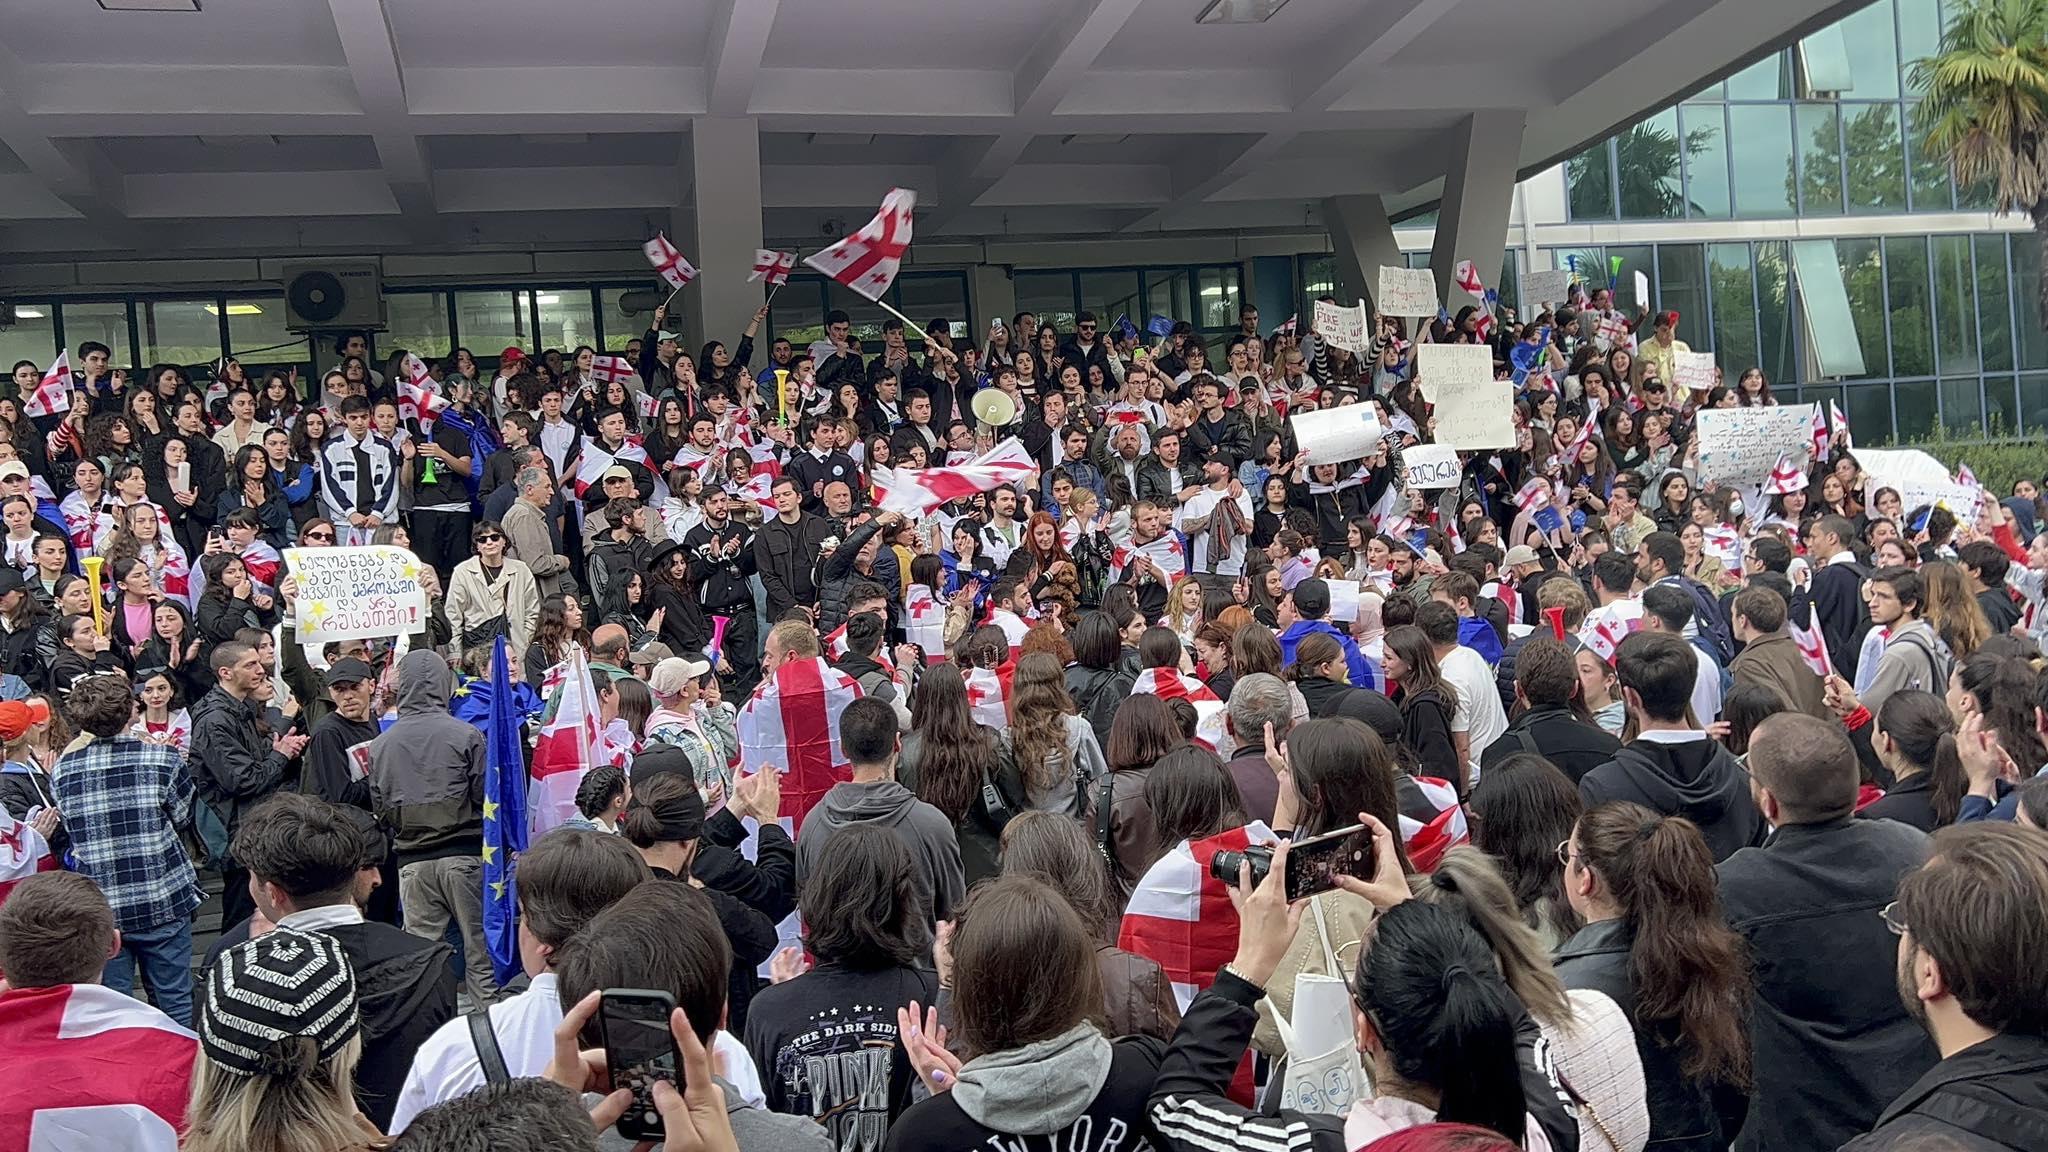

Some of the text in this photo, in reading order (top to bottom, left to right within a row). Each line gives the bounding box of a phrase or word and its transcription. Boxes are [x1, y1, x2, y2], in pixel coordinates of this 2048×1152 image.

[1317, 311, 1338, 326] FIRE
[298, 553, 408, 570] ხელოვნება და
[309, 567, 397, 585] კულტურა
[301, 580, 416, 600] ყვავის ევროპაში
[337, 596, 397, 612] და არა
[321, 606, 418, 632] რუსეთში!
[792, 1031, 820, 1048] THE
[824, 1023, 865, 1037] DARK
[806, 1048, 892, 1116] PINK
